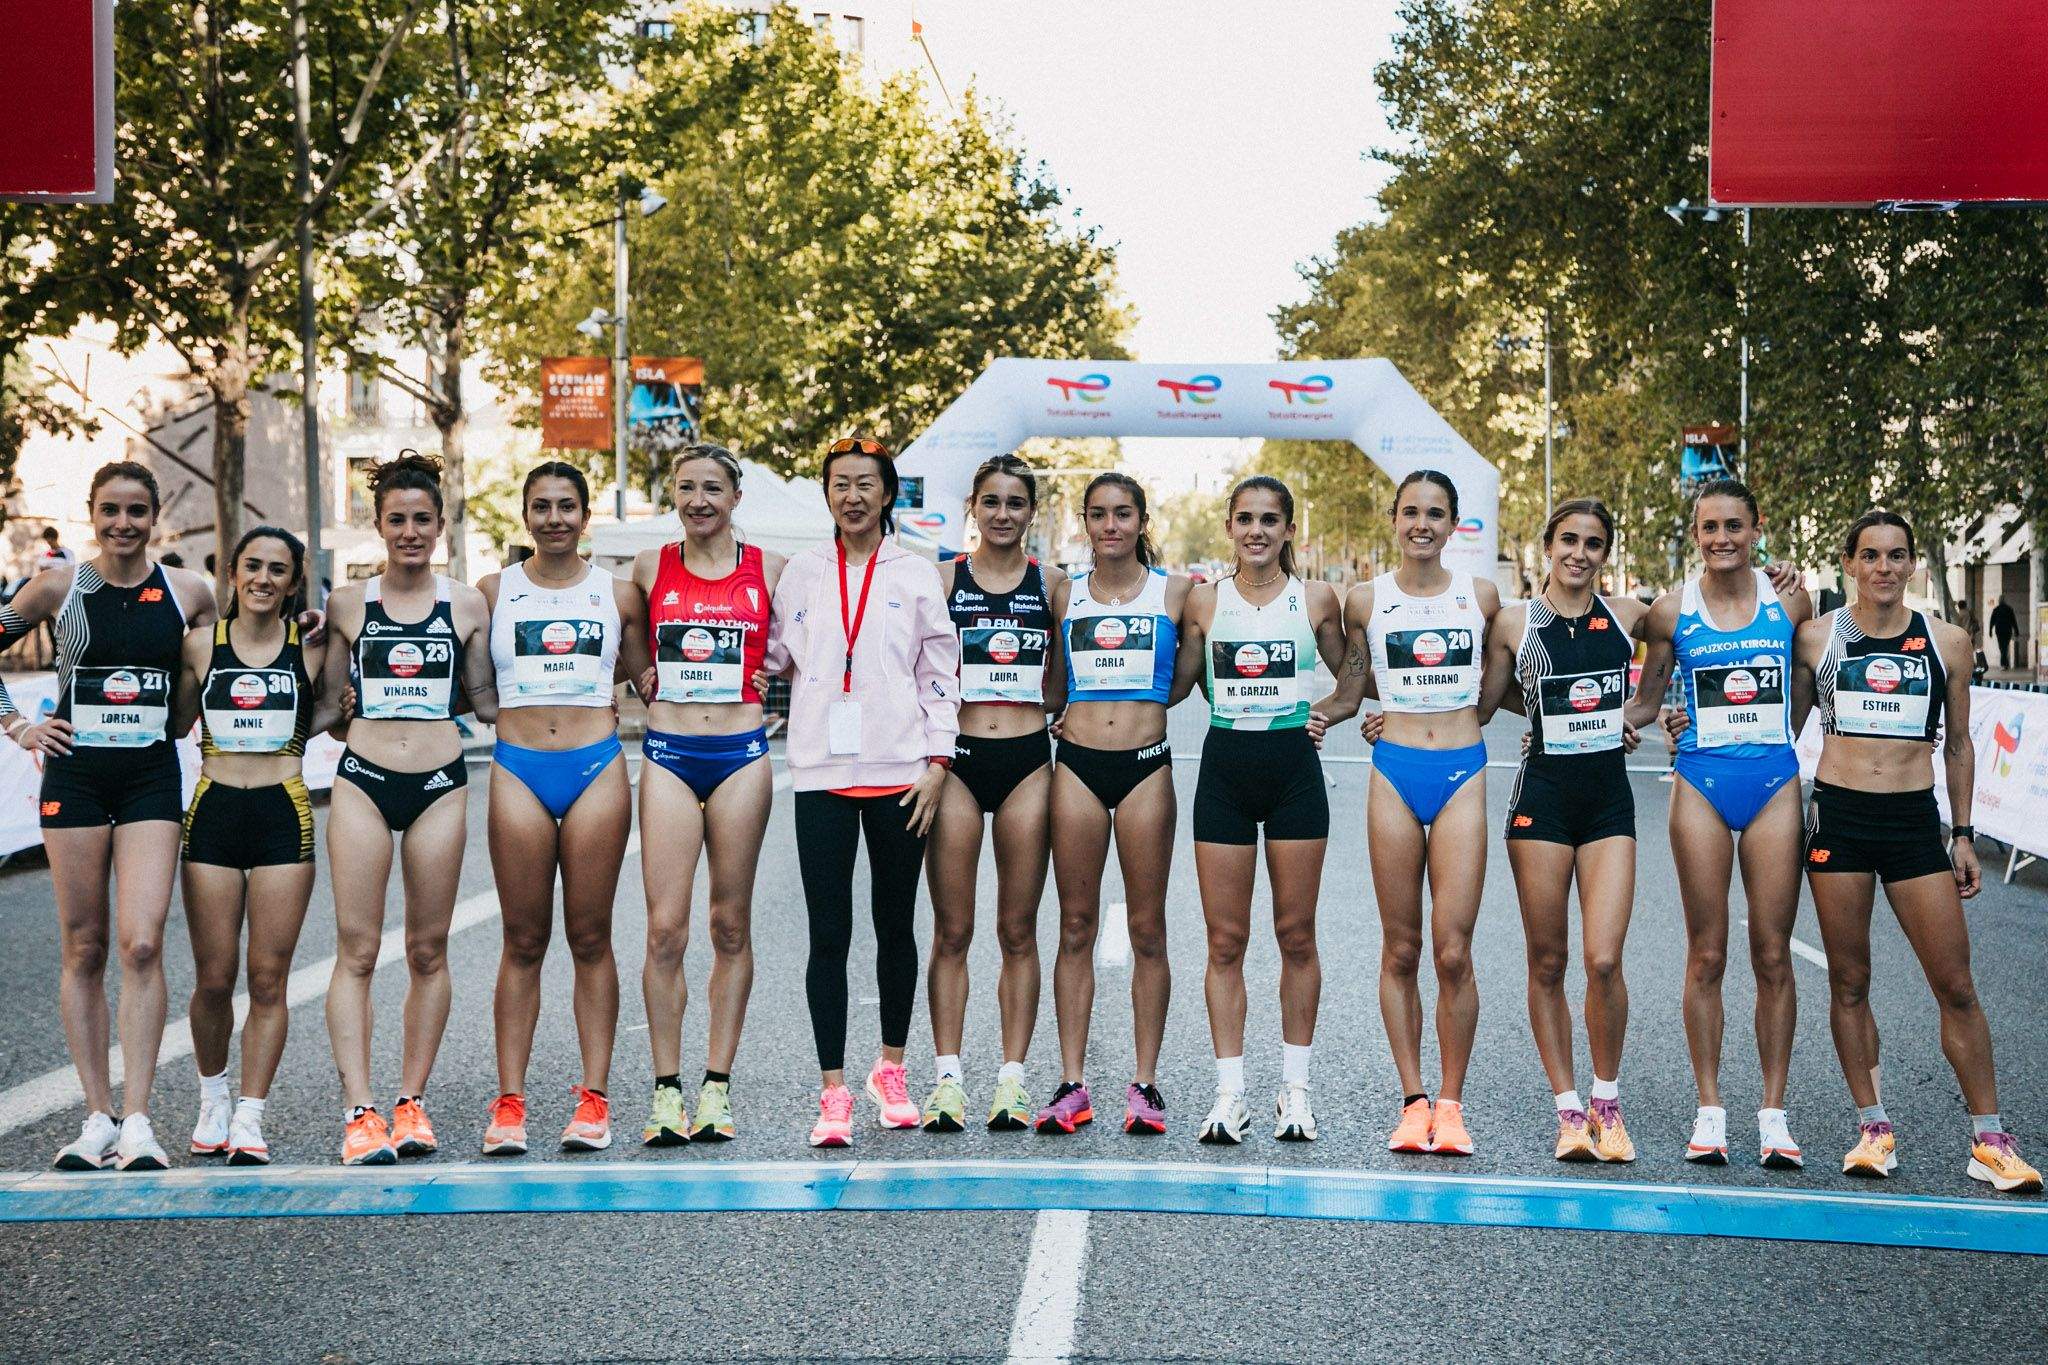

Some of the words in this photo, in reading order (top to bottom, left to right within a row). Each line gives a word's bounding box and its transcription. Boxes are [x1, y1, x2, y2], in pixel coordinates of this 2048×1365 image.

[1685, 433, 1708, 443] ISLA
[578, 621, 602, 640] 24
[1128, 617, 1152, 635] 29
[717, 630, 739, 649] 31
[1022, 632, 1043, 651] 22
[1447, 630, 1471, 650] 20
[425, 642, 449, 663] 23
[1269, 643, 1293, 662] 25
[1689, 641, 1740, 658] GIPUZKOA
[1095, 657, 1126, 668] CARLA
[1902, 661, 1927, 680] 34
[268, 673, 292, 694] 30
[680, 669, 713, 682] ISABEL
[989, 671, 1018, 683] LAURA
[1403, 675, 1414, 686] M.
[1416, 673, 1459, 686] SERRANO
[1759, 669, 1779, 688] 21
[1227, 686, 1238, 697] M.
[1240, 686, 1279, 697] GARZZIA
[1602, 674, 1622, 695] 26
[1862, 700, 1900, 713] ESTHER
[101, 713, 140, 724] LORENA
[233, 718, 263, 729] ANNIE
[1568, 717, 1607, 733] DANIELA
[1728, 712, 1758, 724] LOREA
[647, 738, 668, 749] ADM
[1137, 744, 1162, 761] NIKE
[423, 779, 454, 791] adidas
